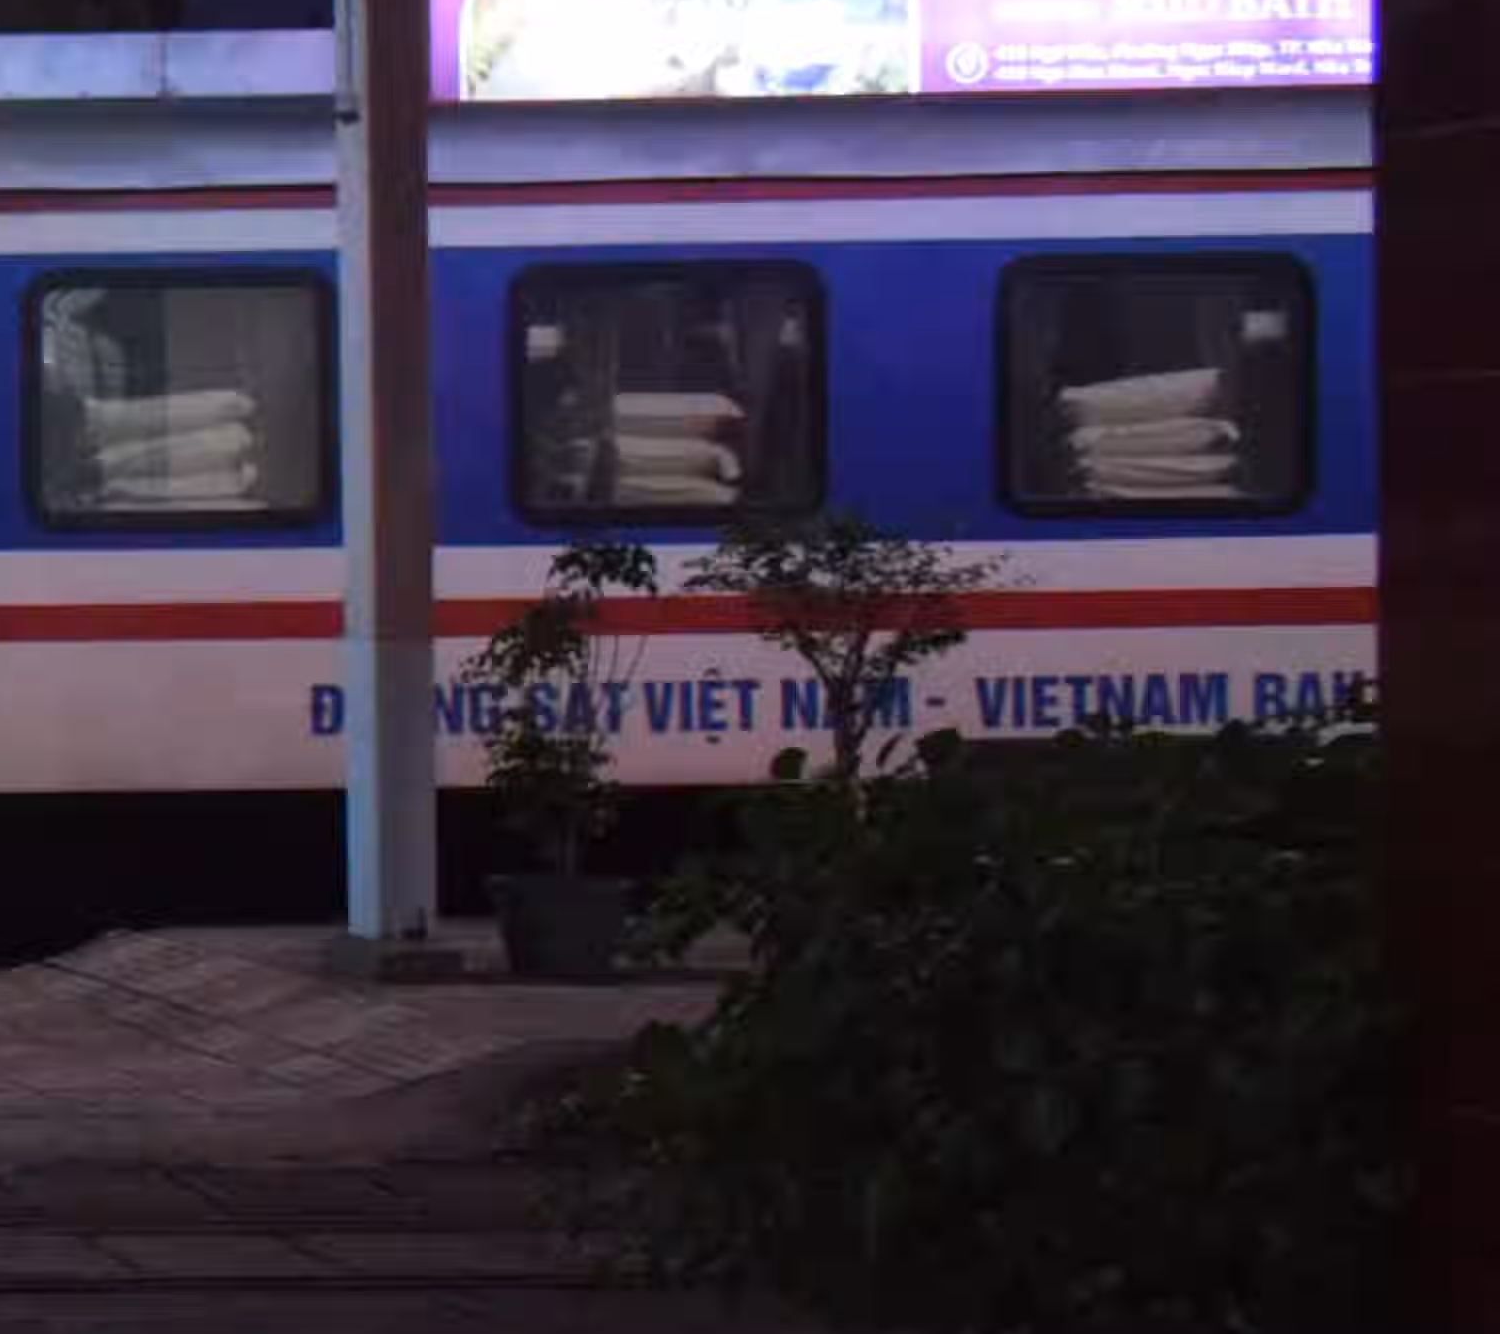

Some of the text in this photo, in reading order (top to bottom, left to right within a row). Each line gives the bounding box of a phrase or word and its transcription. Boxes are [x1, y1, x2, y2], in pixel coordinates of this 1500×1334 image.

[310, 683, 505, 735] ĐNG
[644, 669, 760, 744] VIỆT
[975, 673, 1229, 727] VIETNAM
